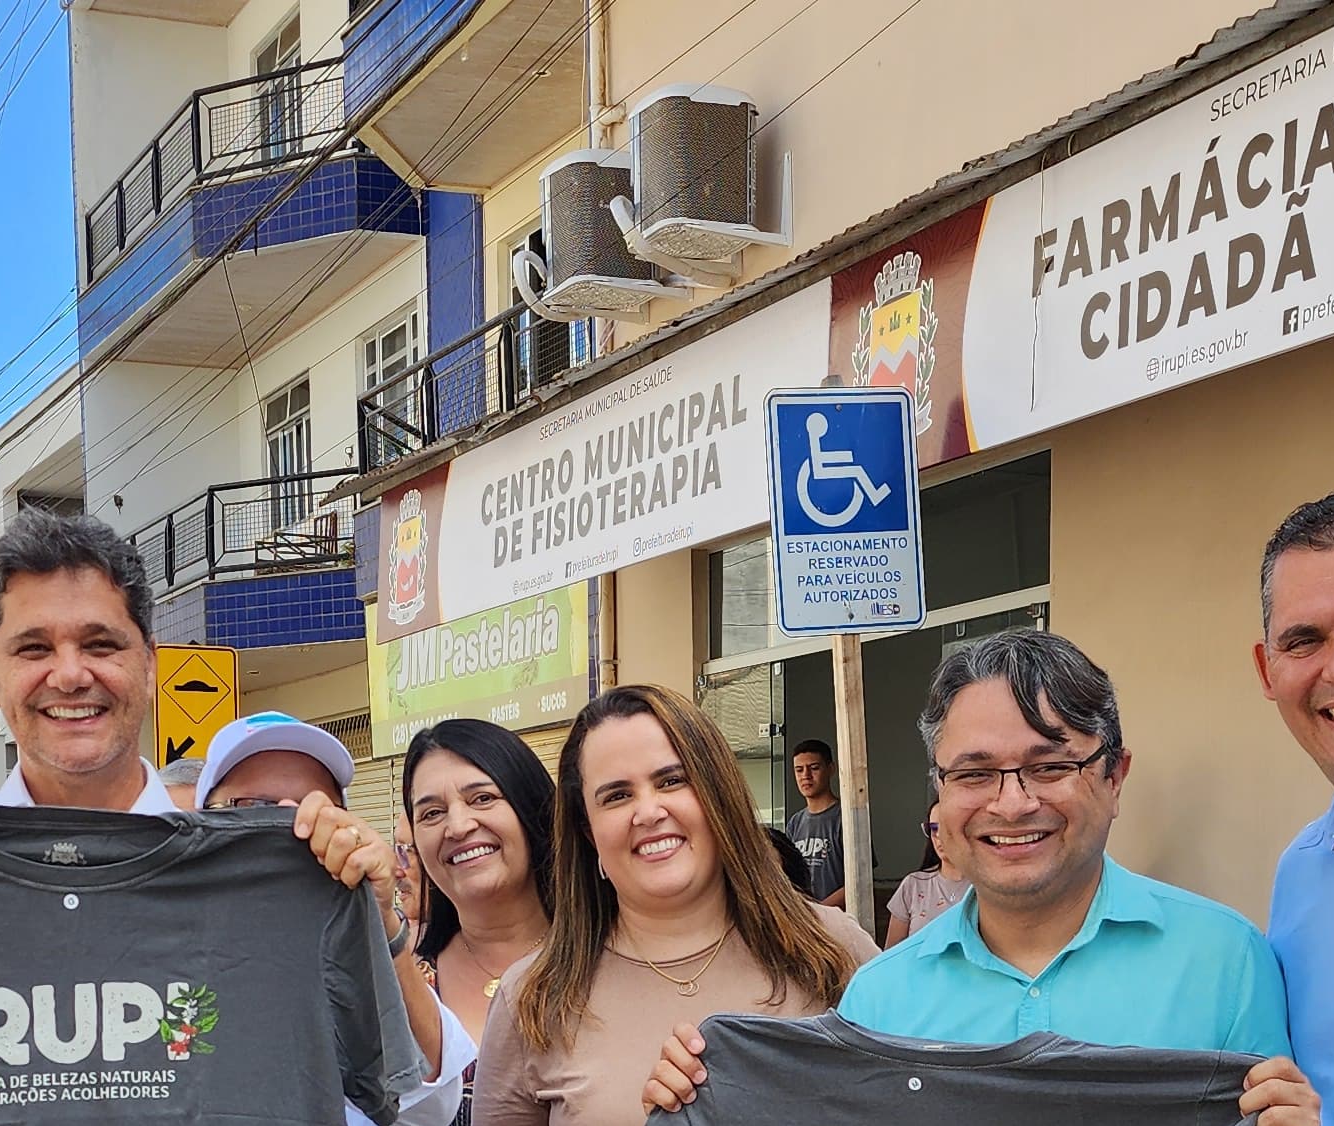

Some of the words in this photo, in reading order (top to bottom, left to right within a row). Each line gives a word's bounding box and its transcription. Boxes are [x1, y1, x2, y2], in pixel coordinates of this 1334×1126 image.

[1210, 48, 1327, 122] SECRETARIA
[1080, 187, 1317, 360] CIDADÃ
[1161, 329, 1249, 375] irupi.es.gov.br
[539, 408, 583, 440] SECRETARIA
[585, 388, 628, 420] MUNICIPAL
[630, 379, 642, 399] DE
[643, 365, 673, 392] SAÚDE
[481, 449, 574, 526] CENTRO
[584, 374, 748, 486] MUNICIPAL
[494, 517, 523, 568] DE
[531, 442, 722, 555] FISIOTERAPIA
[787, 537, 908, 553] ESTACIONAMENTO
[808, 555, 889, 569] RESERVADO
[797, 574, 833, 587] PARA
[836, 570, 902, 585] VEÍCULOS
[804, 587, 898, 603] AUTORIZADOS
[396, 628, 437, 692] JM
[439, 596, 560, 680] Pastelaria
[540, 691, 568, 713] SUCOS
[10, 1073, 28, 1088] DE
[32, 1071, 98, 1087] BELEZAS
[100, 1069, 176, 1083] NATURAIS
[60, 1084, 170, 1101] ACOLHEDORES
